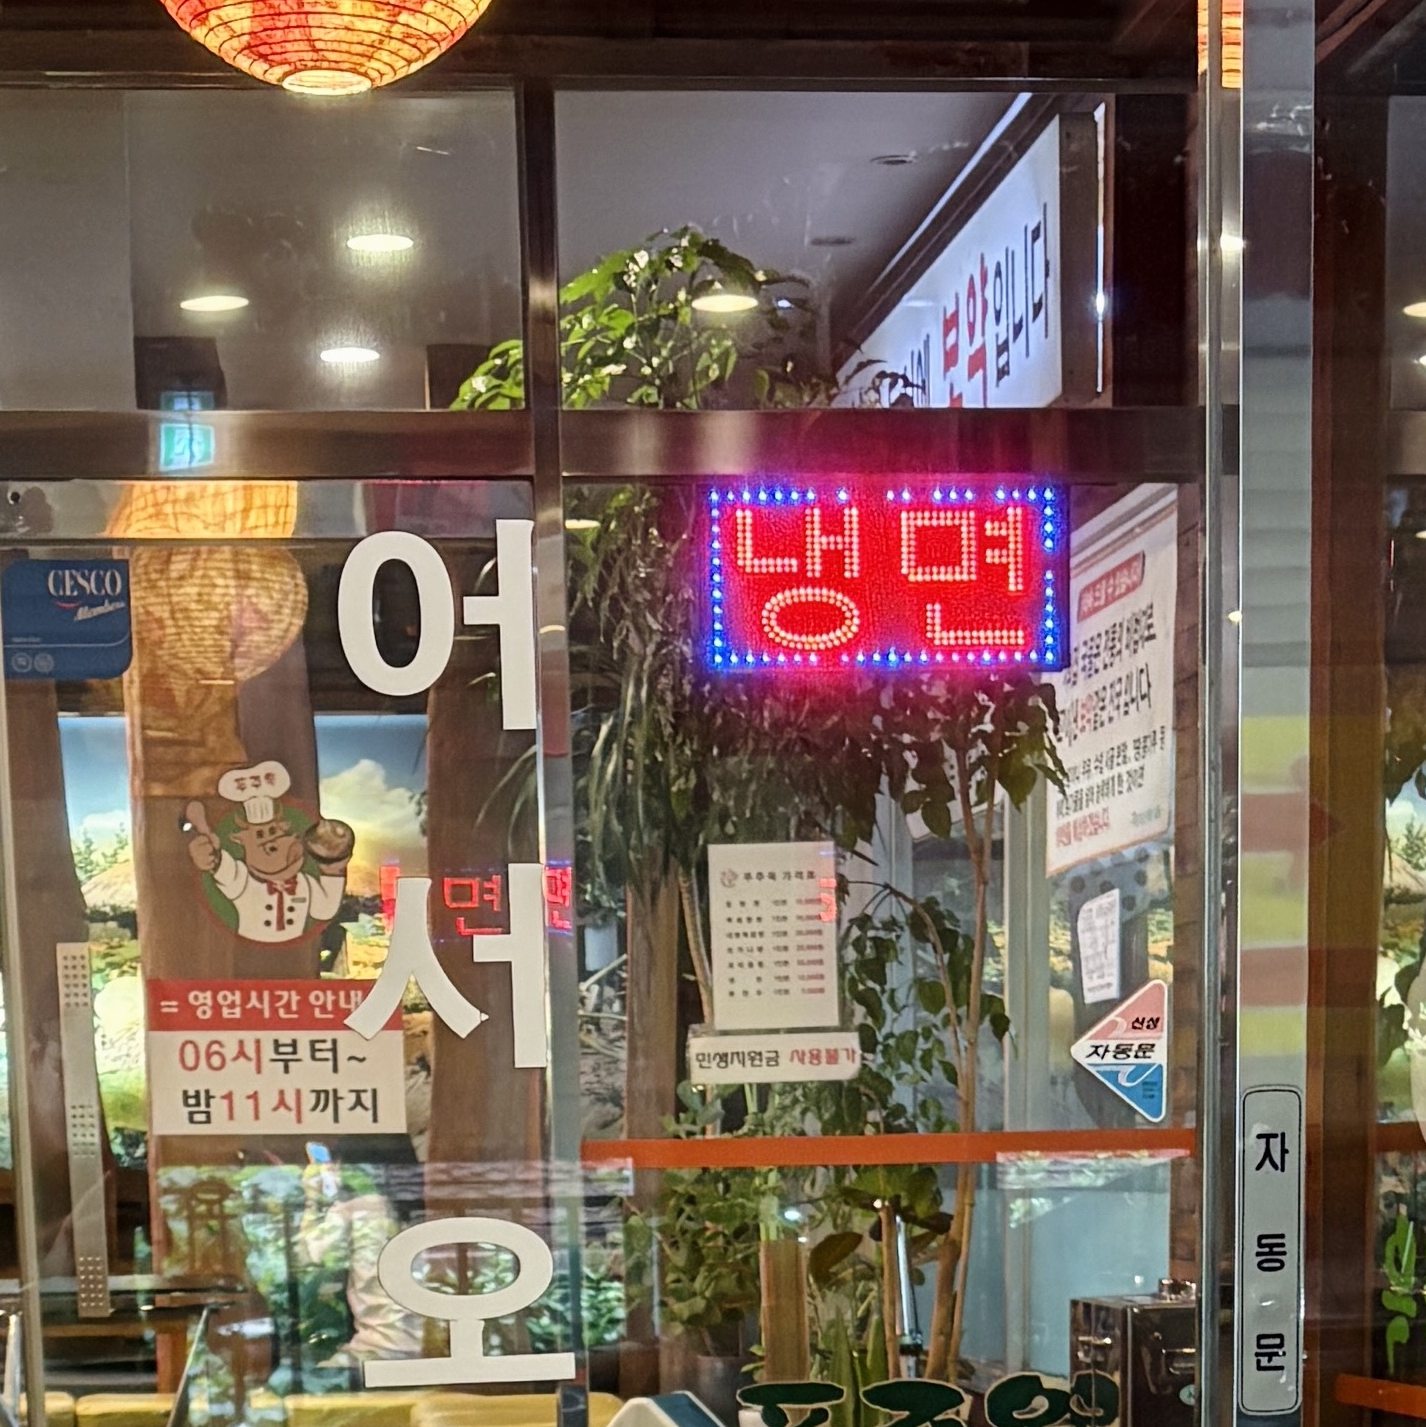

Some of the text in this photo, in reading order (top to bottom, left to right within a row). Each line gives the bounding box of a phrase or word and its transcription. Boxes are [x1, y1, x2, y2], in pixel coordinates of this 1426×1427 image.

[47, 569, 122, 596] CESCO
[735, 505, 1026, 651] 냉면
[187, 989, 363, 1020] 영업시간 안내
[178, 1038, 368, 1076] 06시부터~
[695, 1047, 858, 1070] 민생지원금 사용불가
[1085, 1043, 1156, 1060] 자동문
[181, 1087, 379, 1125] 밤11시까지
[1253, 1130, 1291, 1374] 자동문
